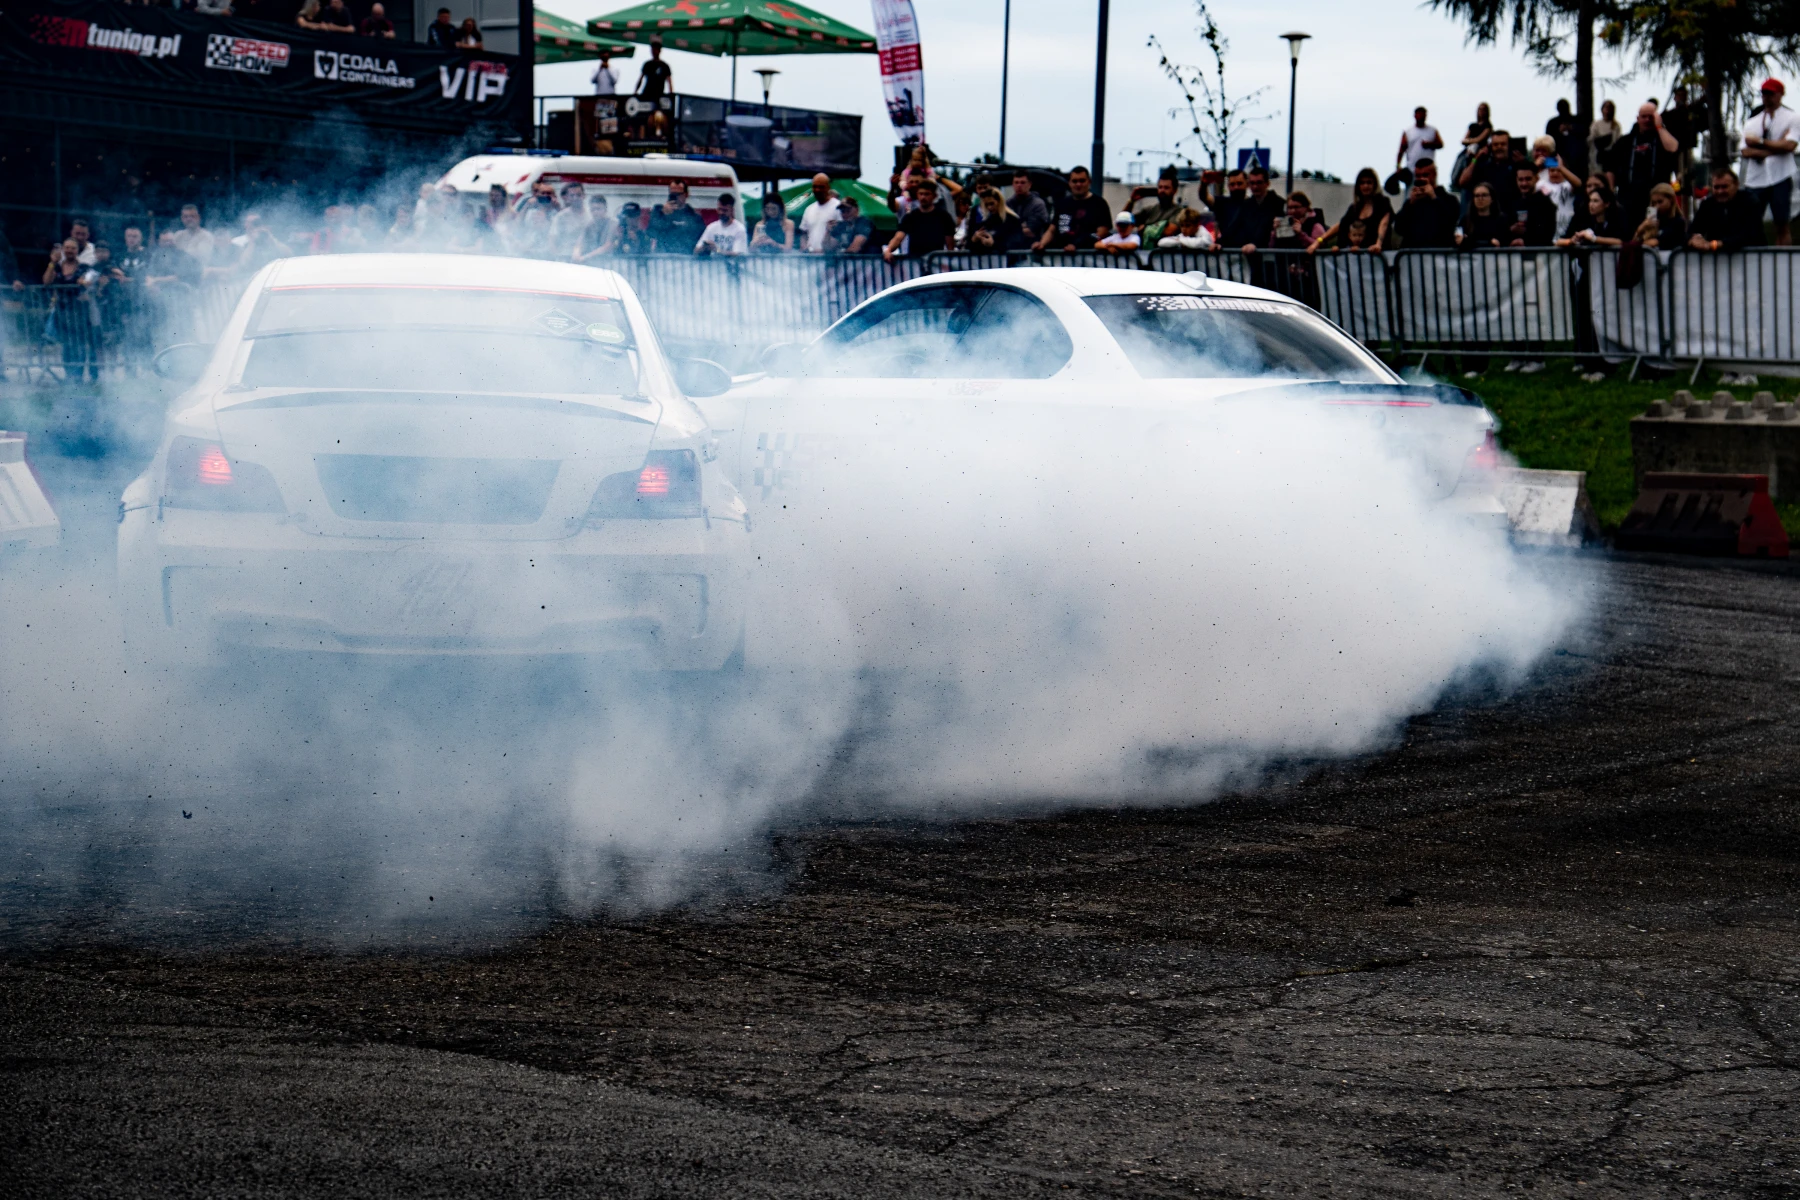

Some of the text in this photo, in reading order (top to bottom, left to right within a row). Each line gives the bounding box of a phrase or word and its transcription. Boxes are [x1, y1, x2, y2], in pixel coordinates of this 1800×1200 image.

[231, 38, 289, 61] SPEED
[220, 51, 270, 72] SHOW
[339, 53, 399, 75] COALA
[339, 70, 416, 89] CONTAINERS
[439, 65, 508, 103] VIP
